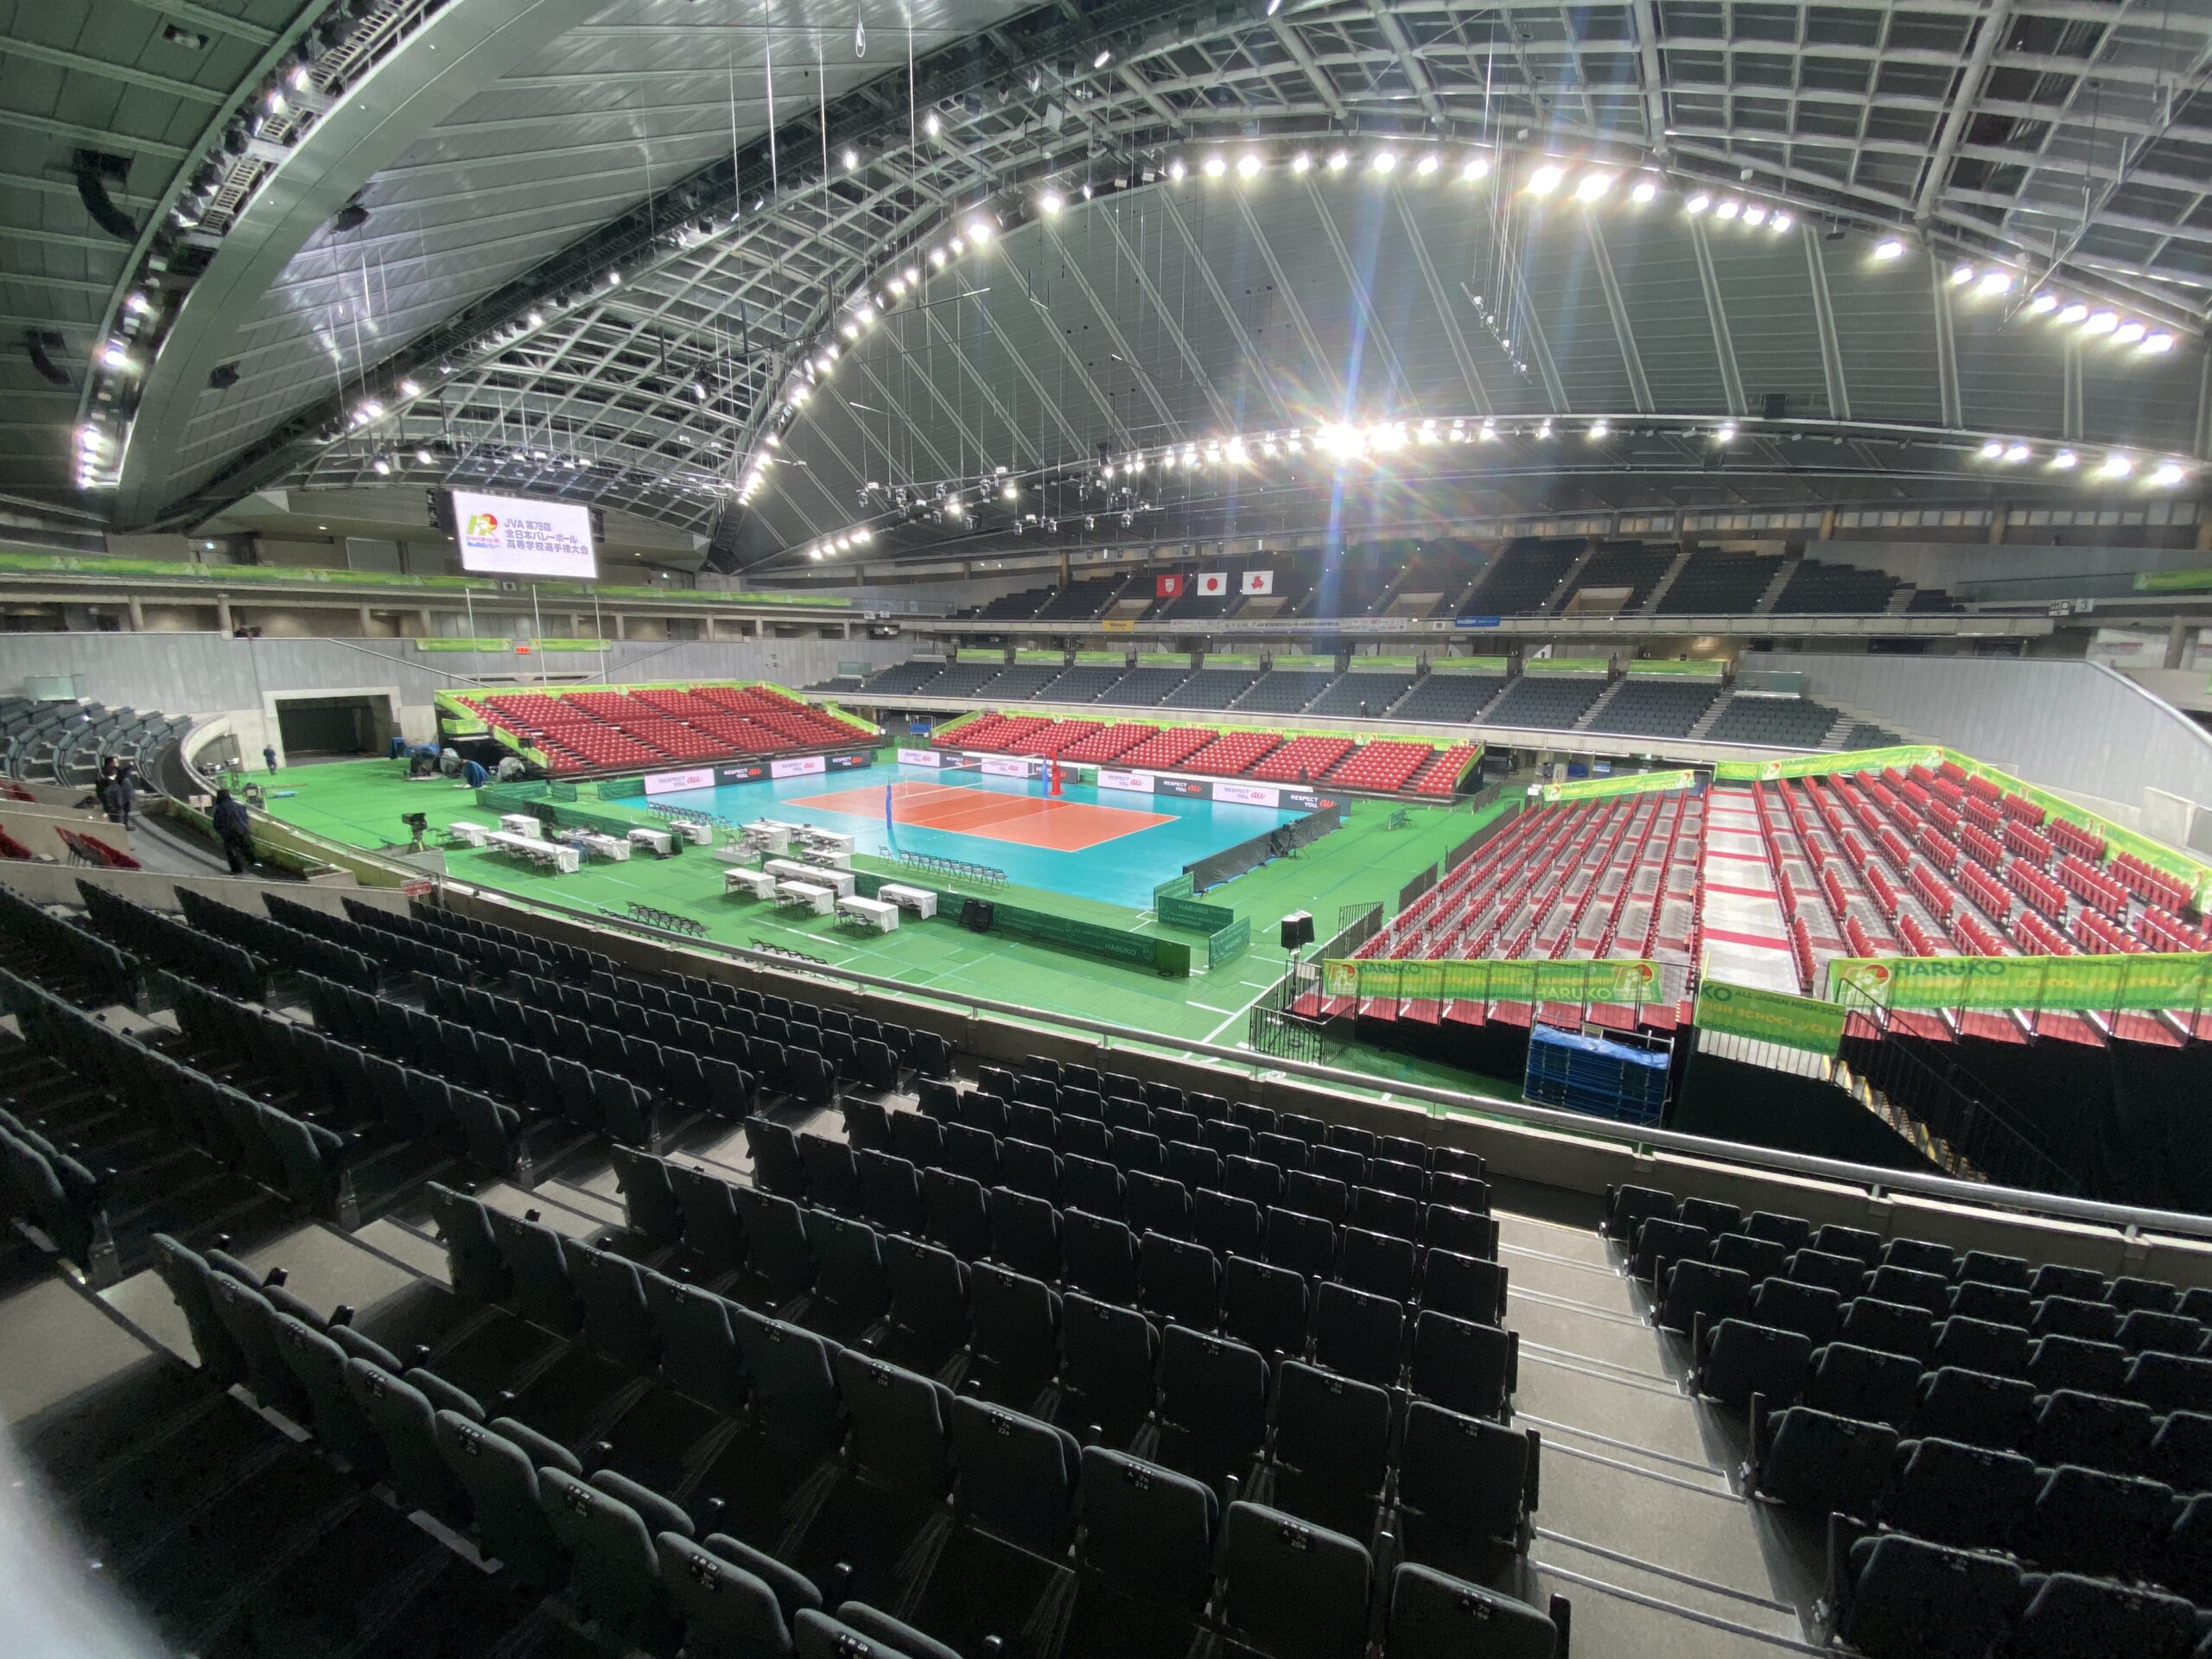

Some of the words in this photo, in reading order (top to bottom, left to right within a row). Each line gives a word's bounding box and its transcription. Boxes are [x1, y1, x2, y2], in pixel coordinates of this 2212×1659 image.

[505, 518, 524, 529] JVA
[505, 528, 578, 543] 全日本バレーボール
[506, 538, 589, 554] 高等学校選手権大会
[2050, 601, 2070, 611] 出口
[2082, 601, 2088, 610] 3
[1781, 757, 1820, 766] HARUKO
[1319, 799, 1337, 808] au
[1179, 904, 1209, 914] HARUKO
[1105, 943, 1136, 956] HARUKO
[1358, 963, 1421, 975] HARUKO
[1894, 960, 2005, 976] HARUKO
[1536, 987, 1611, 1000] HARUKO
[1735, 990, 1752, 1000] ALL
[1790, 1001, 1818, 1011] HIGH
[1700, 1001, 1732, 1014] HIGH
[1737, 1008, 1792, 1027] SCHOOL
[1699, 1020, 1739, 1033] SCHOOL
